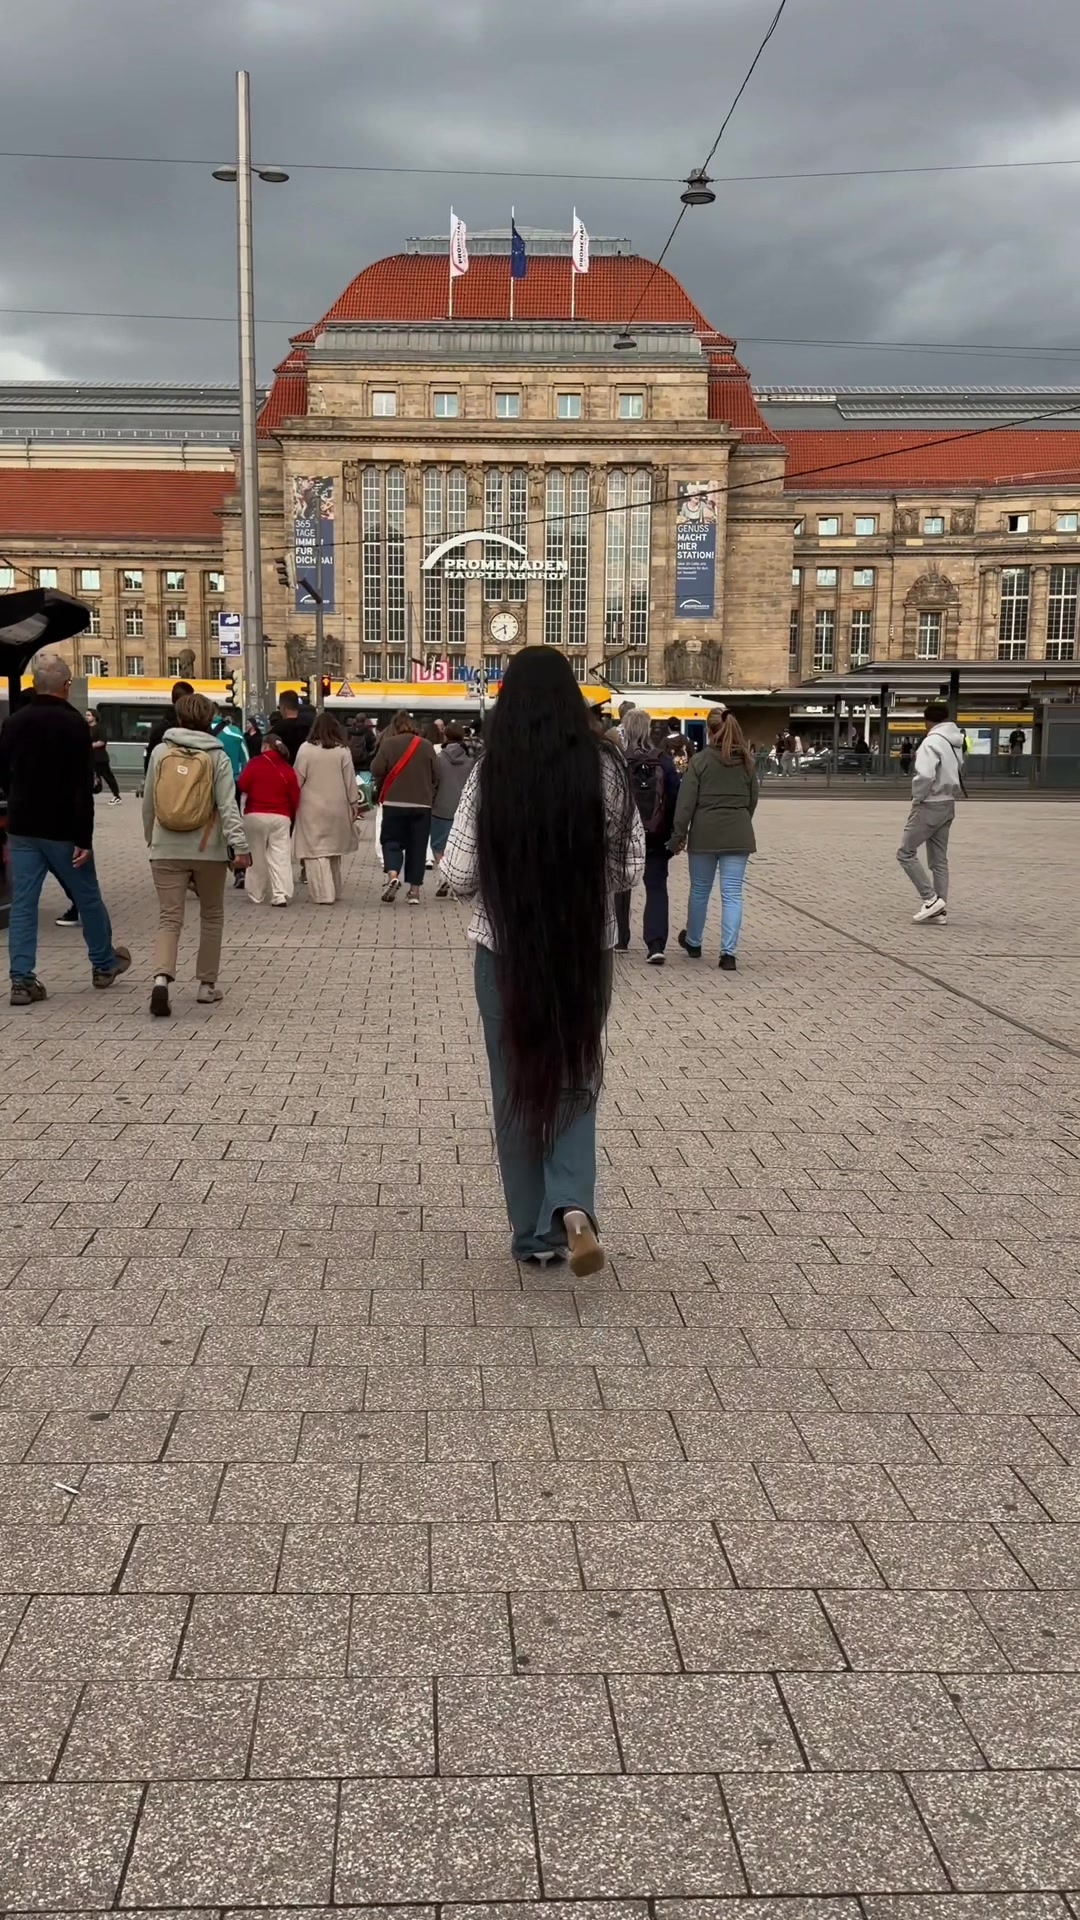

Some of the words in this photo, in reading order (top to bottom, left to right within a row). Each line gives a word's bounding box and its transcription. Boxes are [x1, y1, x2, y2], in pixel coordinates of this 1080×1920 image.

[295, 519, 311, 528] 365
[295, 528, 316, 537] TAGE
[677, 524, 710, 533] GENUSS
[677, 533, 707, 541] MACHT
[677, 542, 698, 550] HIER
[676, 551, 715, 559] STATION!
[295, 556, 317, 564] DICH
[444, 559, 569, 570] PROMENADEN
[444, 571, 568, 580] HAUPTBAHNHOF
